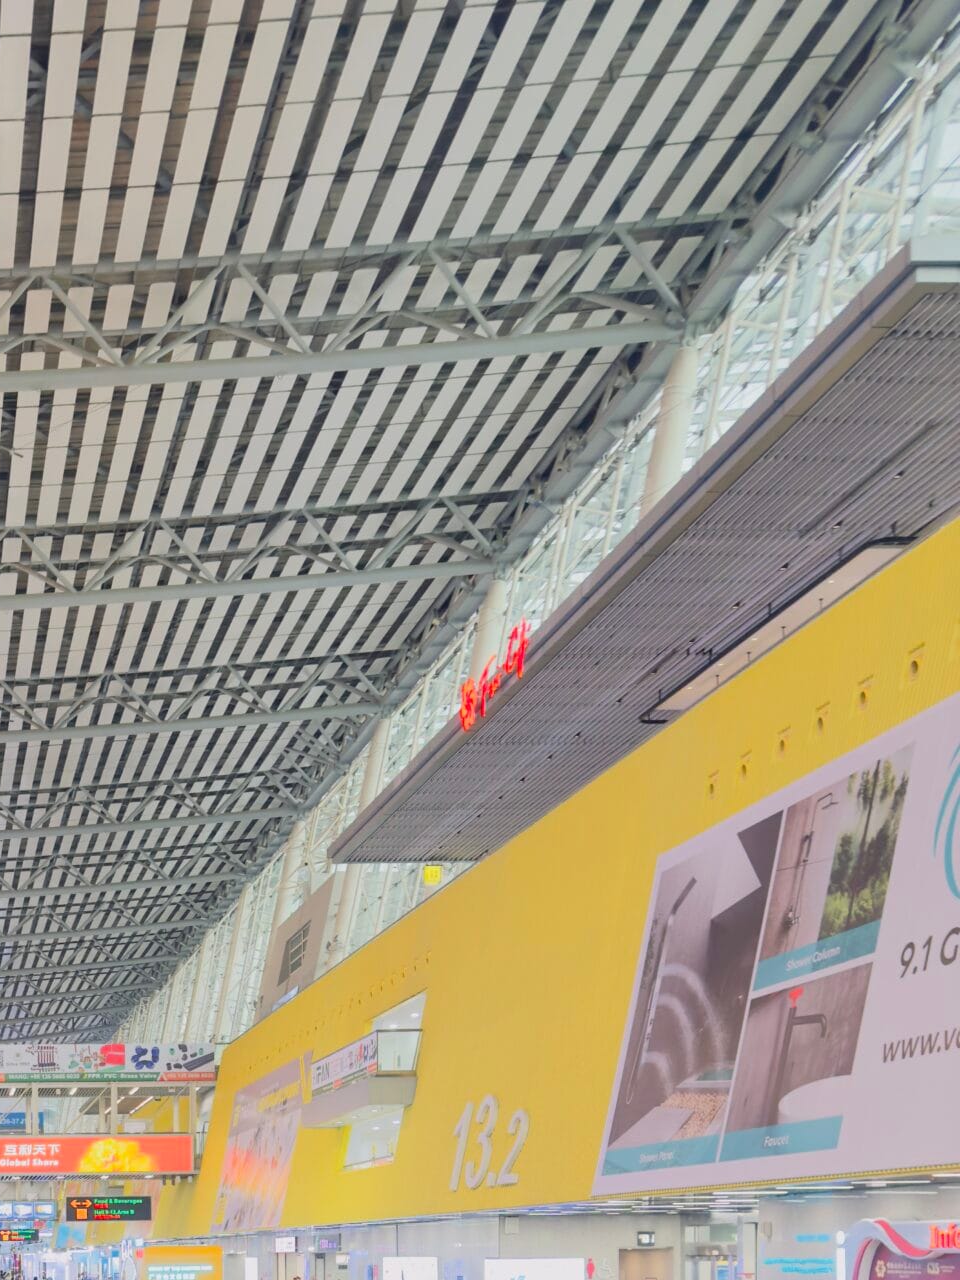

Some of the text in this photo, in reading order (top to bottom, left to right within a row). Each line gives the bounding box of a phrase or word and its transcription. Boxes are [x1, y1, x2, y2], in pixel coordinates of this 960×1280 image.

[899, 934, 933, 979] 9.1
[448, 1094, 530, 1192] 13.2
[764, 1134, 789, 1147] Faucet
[0, 1159, 30, 1167] Global
[32, 1159, 59, 1167] Share
